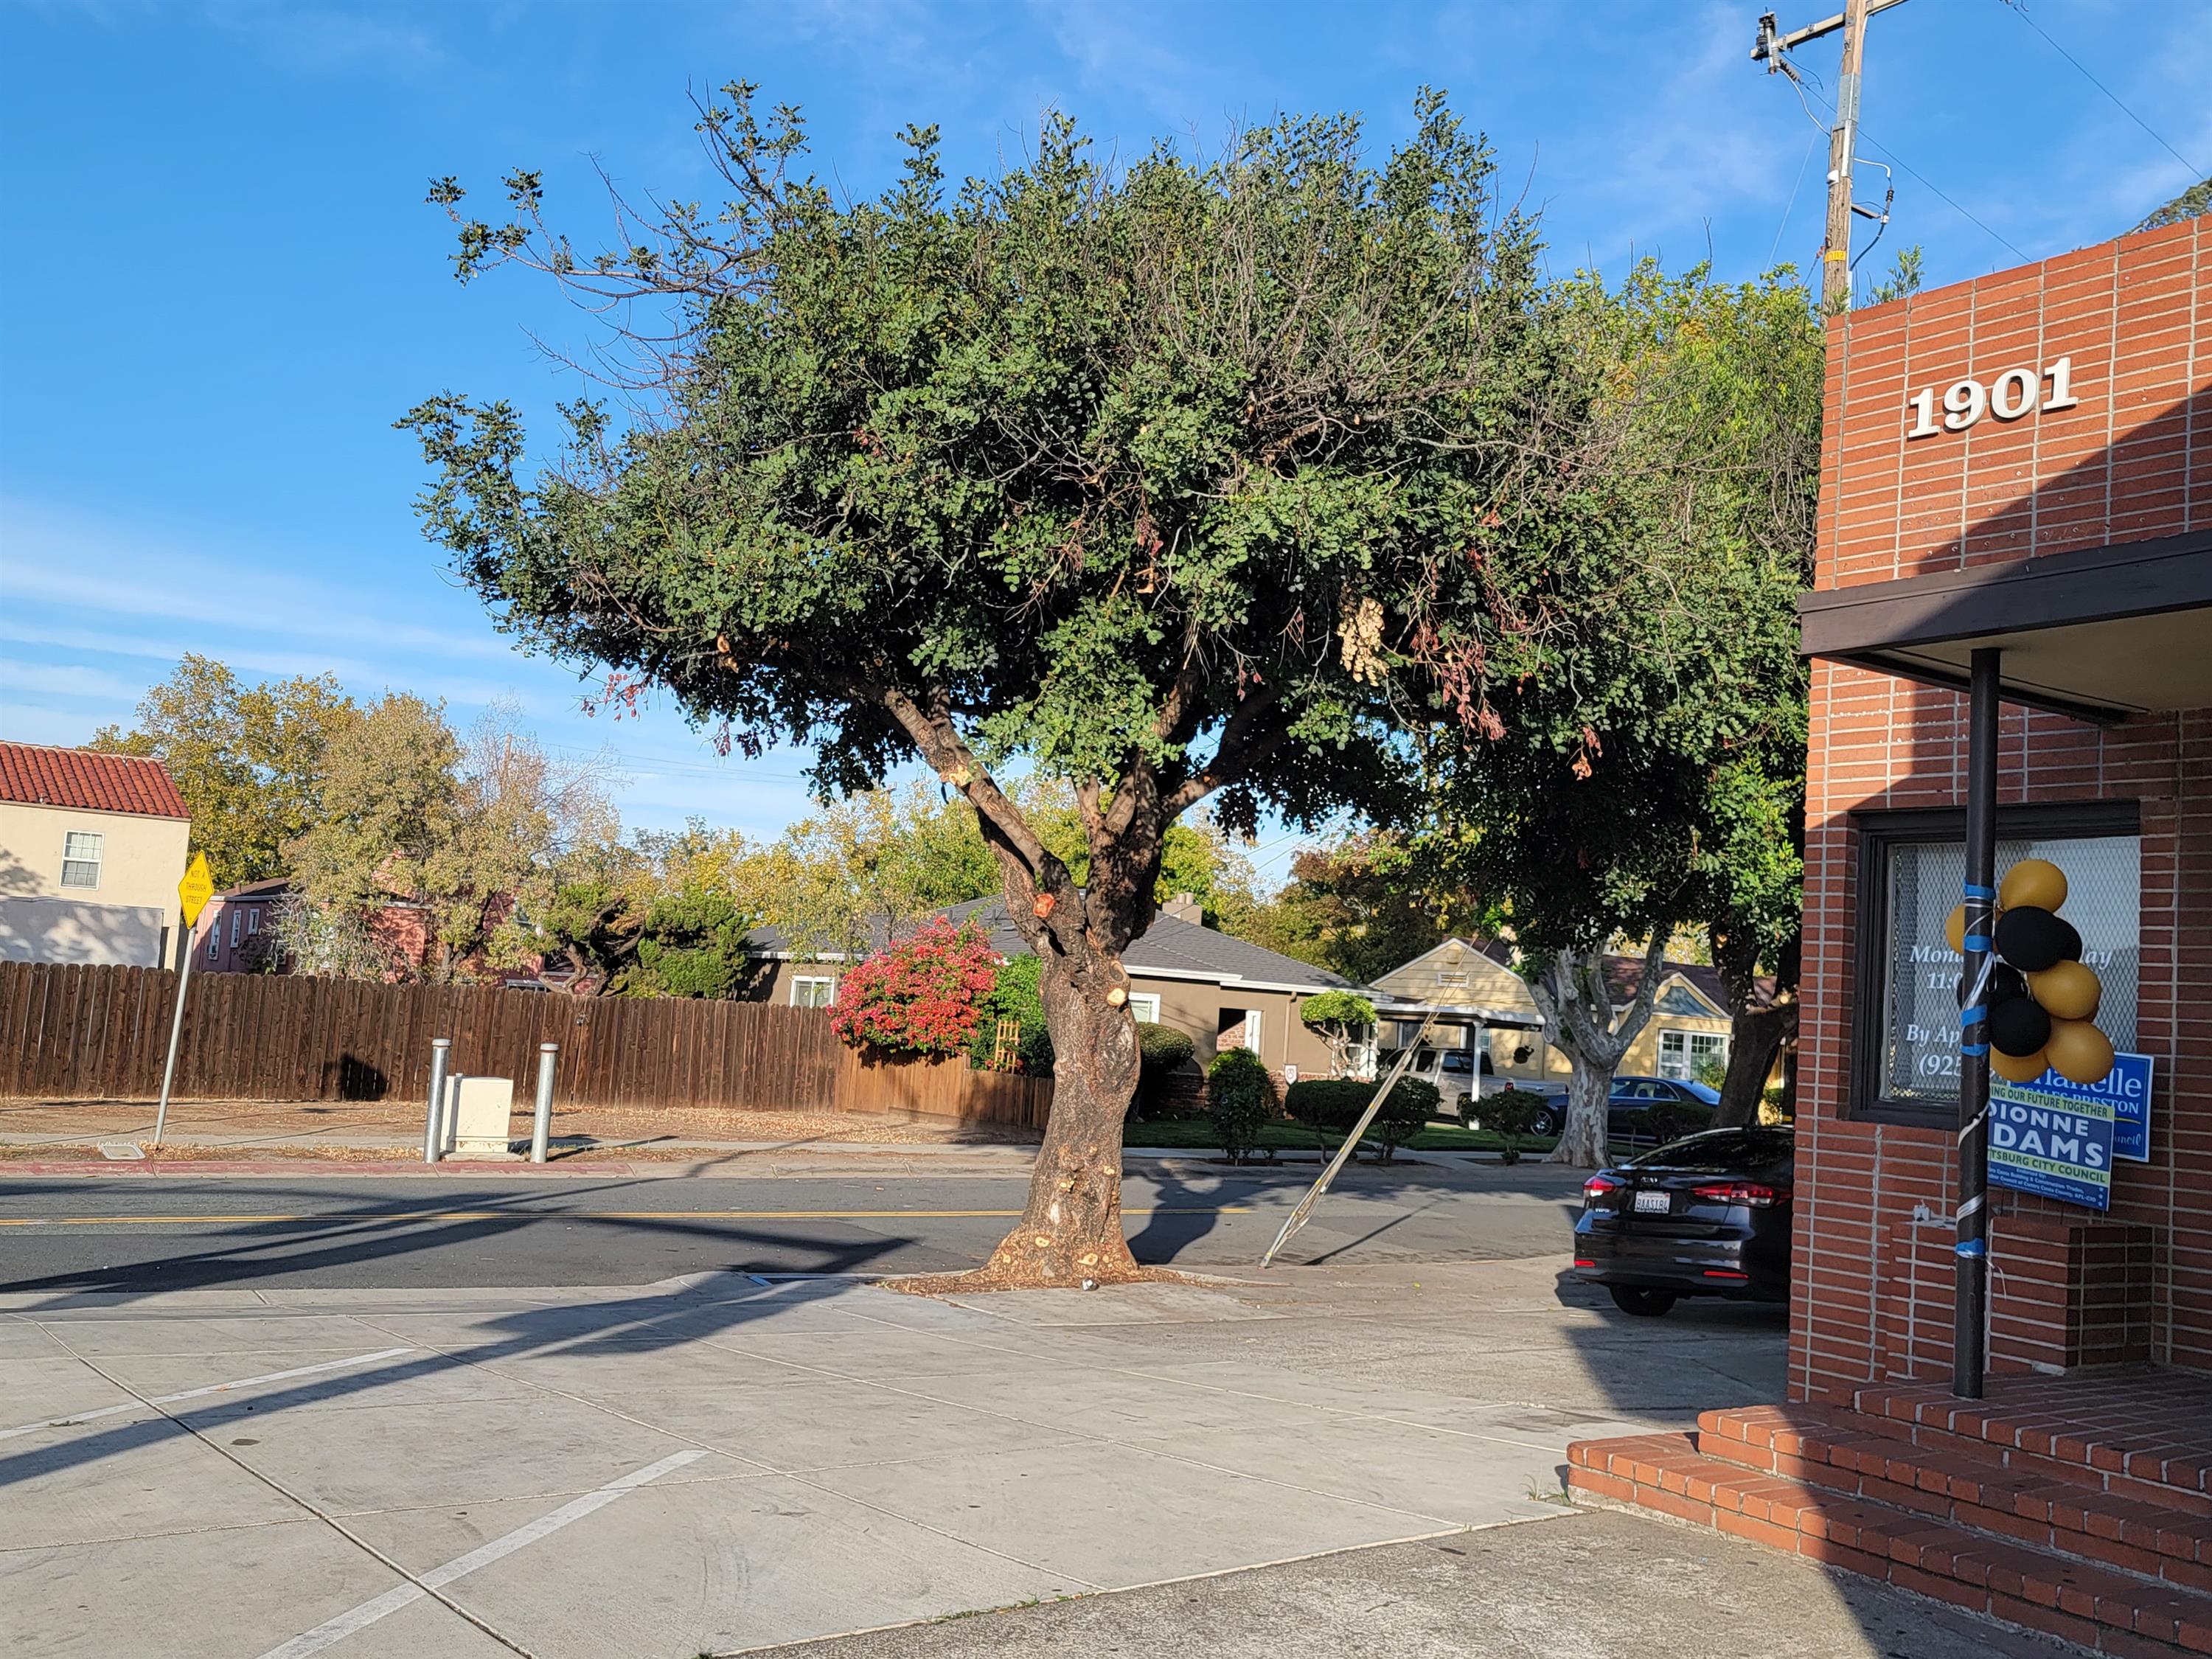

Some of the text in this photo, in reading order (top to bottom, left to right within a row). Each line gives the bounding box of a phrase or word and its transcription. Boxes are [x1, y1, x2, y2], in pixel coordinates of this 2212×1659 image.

[1907, 357, 2079, 438] 1901
[190, 870, 200, 878] NOT
[186, 881, 206, 892] THROUGH
[185, 894, 203, 905] STREET
[1905, 1024, 1930, 1047] By
[2008, 1089, 2025, 1102] OUR
[2027, 1093, 2060, 1108] FUTURE
[2062, 1100, 2108, 1118] TOGETHER
[1993, 1122, 2103, 1167] DAMS
[2032, 1159, 2056, 1172] CITY
[2058, 1165, 2106, 1183] COUNCIL
